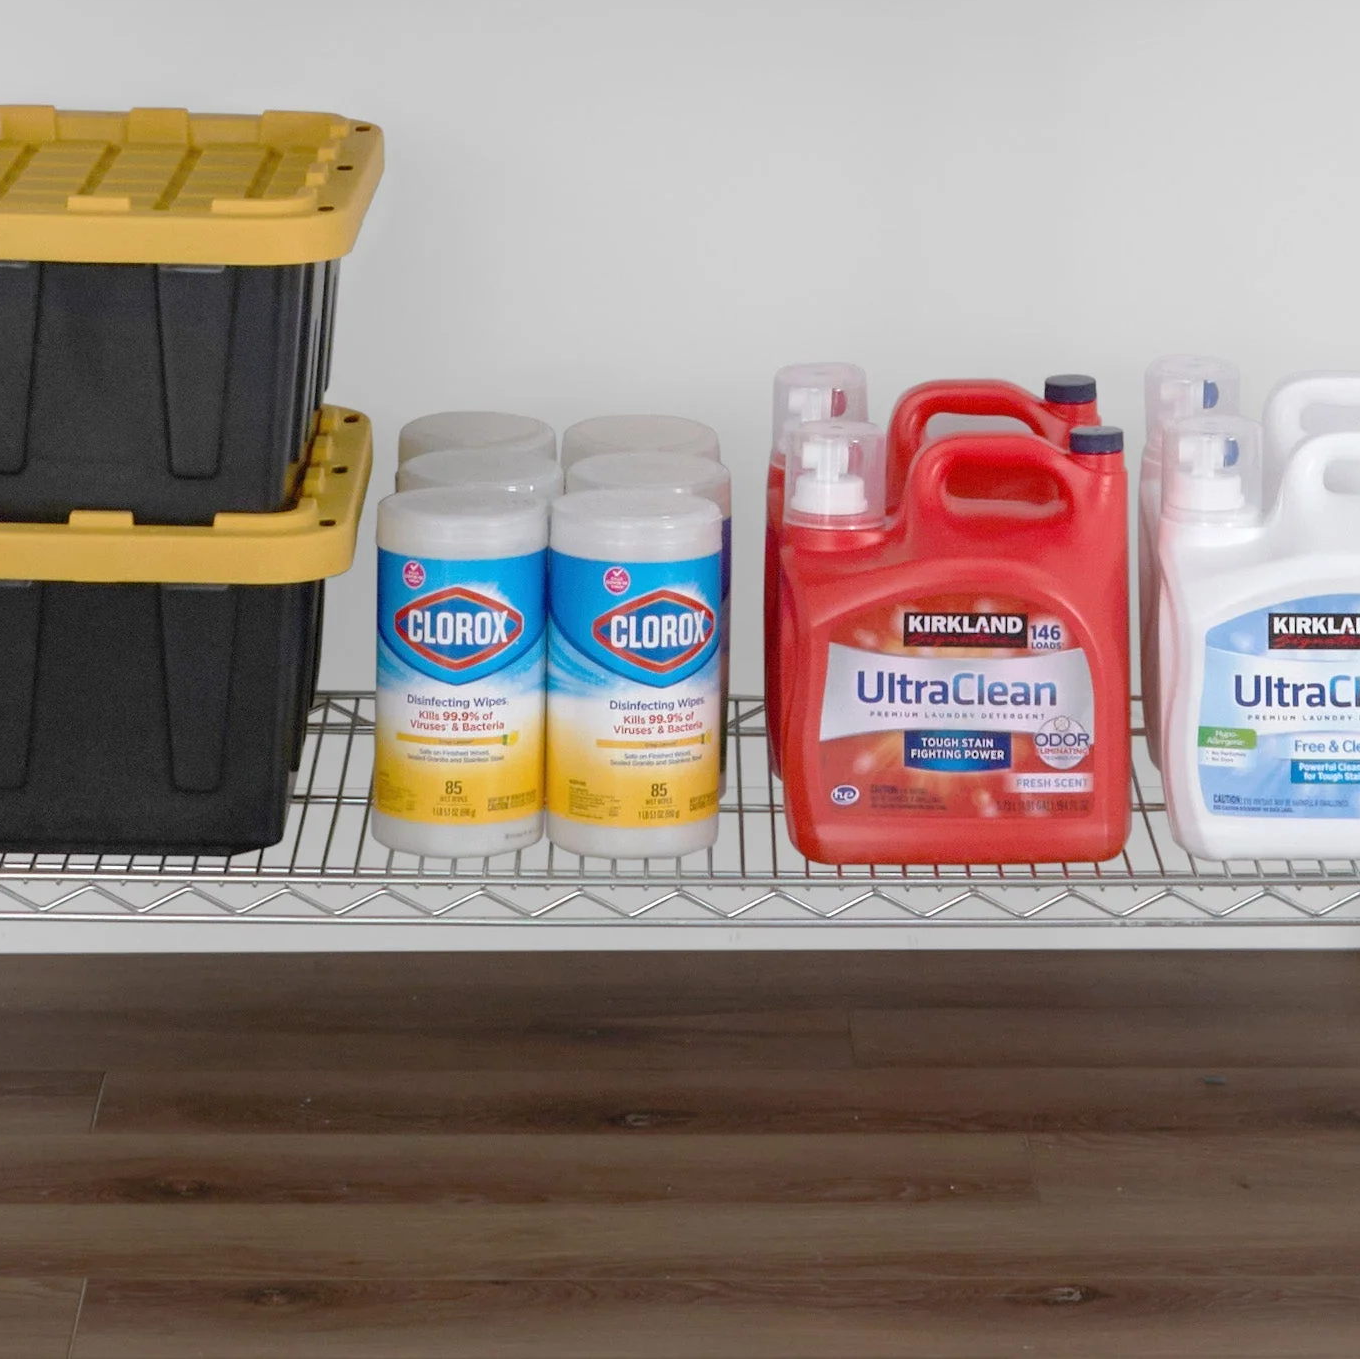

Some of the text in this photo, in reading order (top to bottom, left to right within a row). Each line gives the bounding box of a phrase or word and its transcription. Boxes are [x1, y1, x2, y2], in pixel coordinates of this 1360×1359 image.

[408, 610, 507, 645] CLOROX
[611, 611, 704, 648] CLOROX
[908, 615, 1023, 634] KIRKLAND
[1030, 625, 1061, 640] 146
[858, 671, 1057, 706] UltraClean
[407, 694, 469, 708] Disinfecting
[610, 700, 674, 710] Disinfecting
[419, 711, 479, 721] Kills 99.9%
[623, 714, 682, 724] Kills 99.9%
[463, 721, 504, 731] Bacteria
[668, 722, 702, 733] Bacteria
[921, 738, 993, 748] TOUGH STAIN
[1035, 733, 1090, 747] ODOR
[1295, 740, 1326, 752] Free
[1329, 740, 1339, 752] &
[911, 749, 1004, 760] FIGHTING POWER
[1299, 763, 1336, 772] Powerful
[1318, 772, 1342, 782] Tough
[446, 781, 462, 794] 85
[1016, 779, 1087, 787] FRESH SCENT
[651, 783, 667, 797] 85
